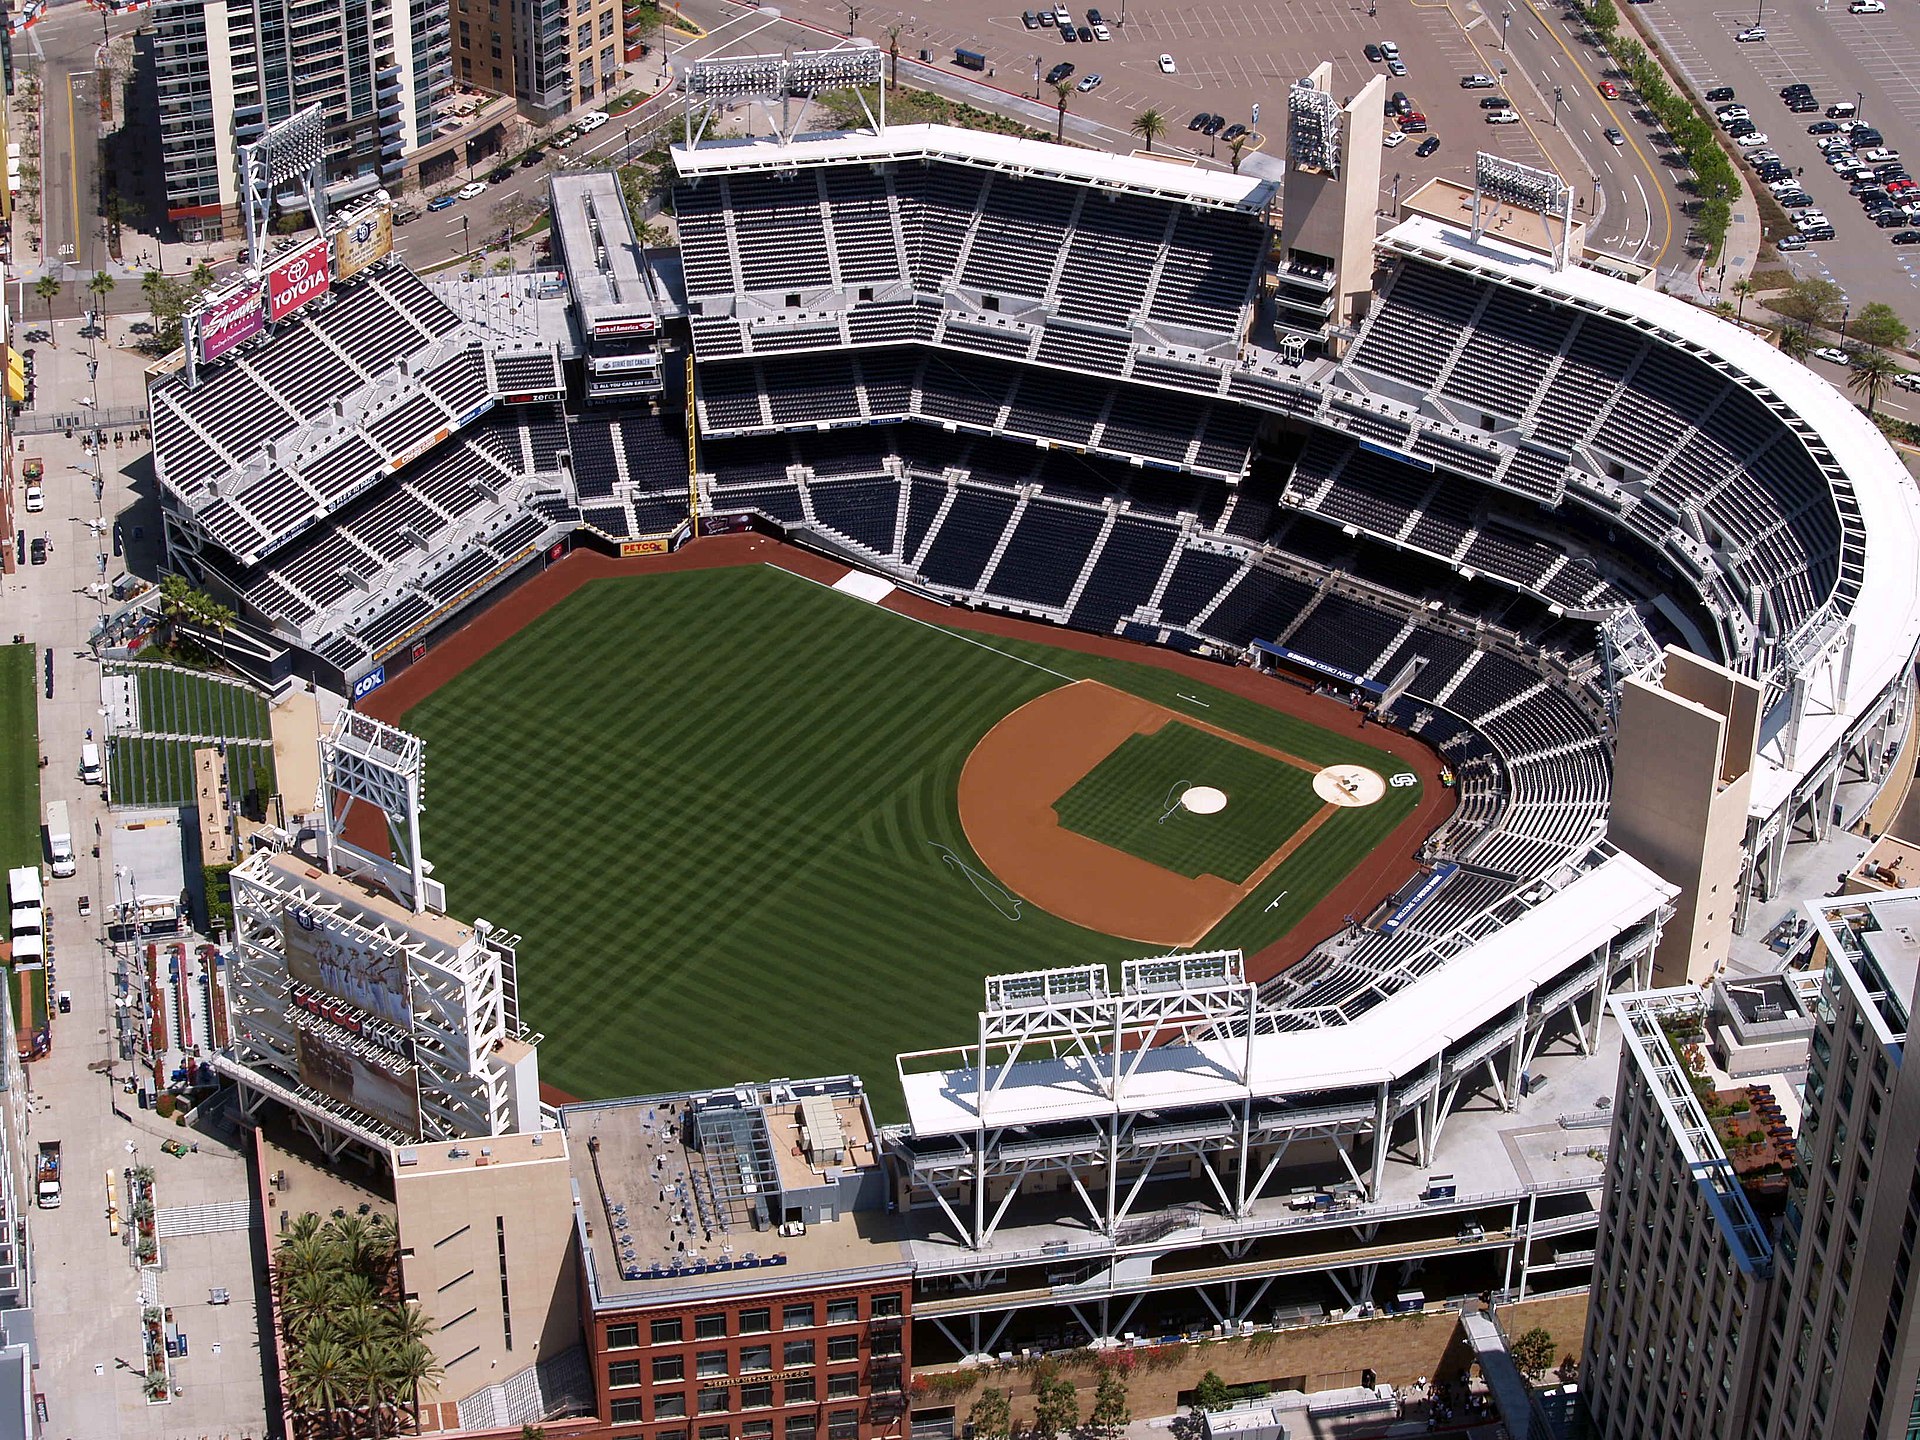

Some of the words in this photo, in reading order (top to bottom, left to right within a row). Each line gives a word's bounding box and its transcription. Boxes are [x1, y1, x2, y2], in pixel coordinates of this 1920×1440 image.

[274, 270, 325, 309] TOYOTA
[203, 299, 261, 339] Sycuan
[616, 324, 639, 332] America
[624, 542, 656, 551] PETCO
[1287, 652, 1317, 667] PADRES
[1316, 662, 1337, 674] DIEGO
[1336, 671, 1353, 680] SAN
[355, 669, 382, 695] COX
[1395, 902, 1416, 920] WELCOME
[1417, 884, 1434, 899] PETCO
[1429, 874, 1443, 887] PARK
